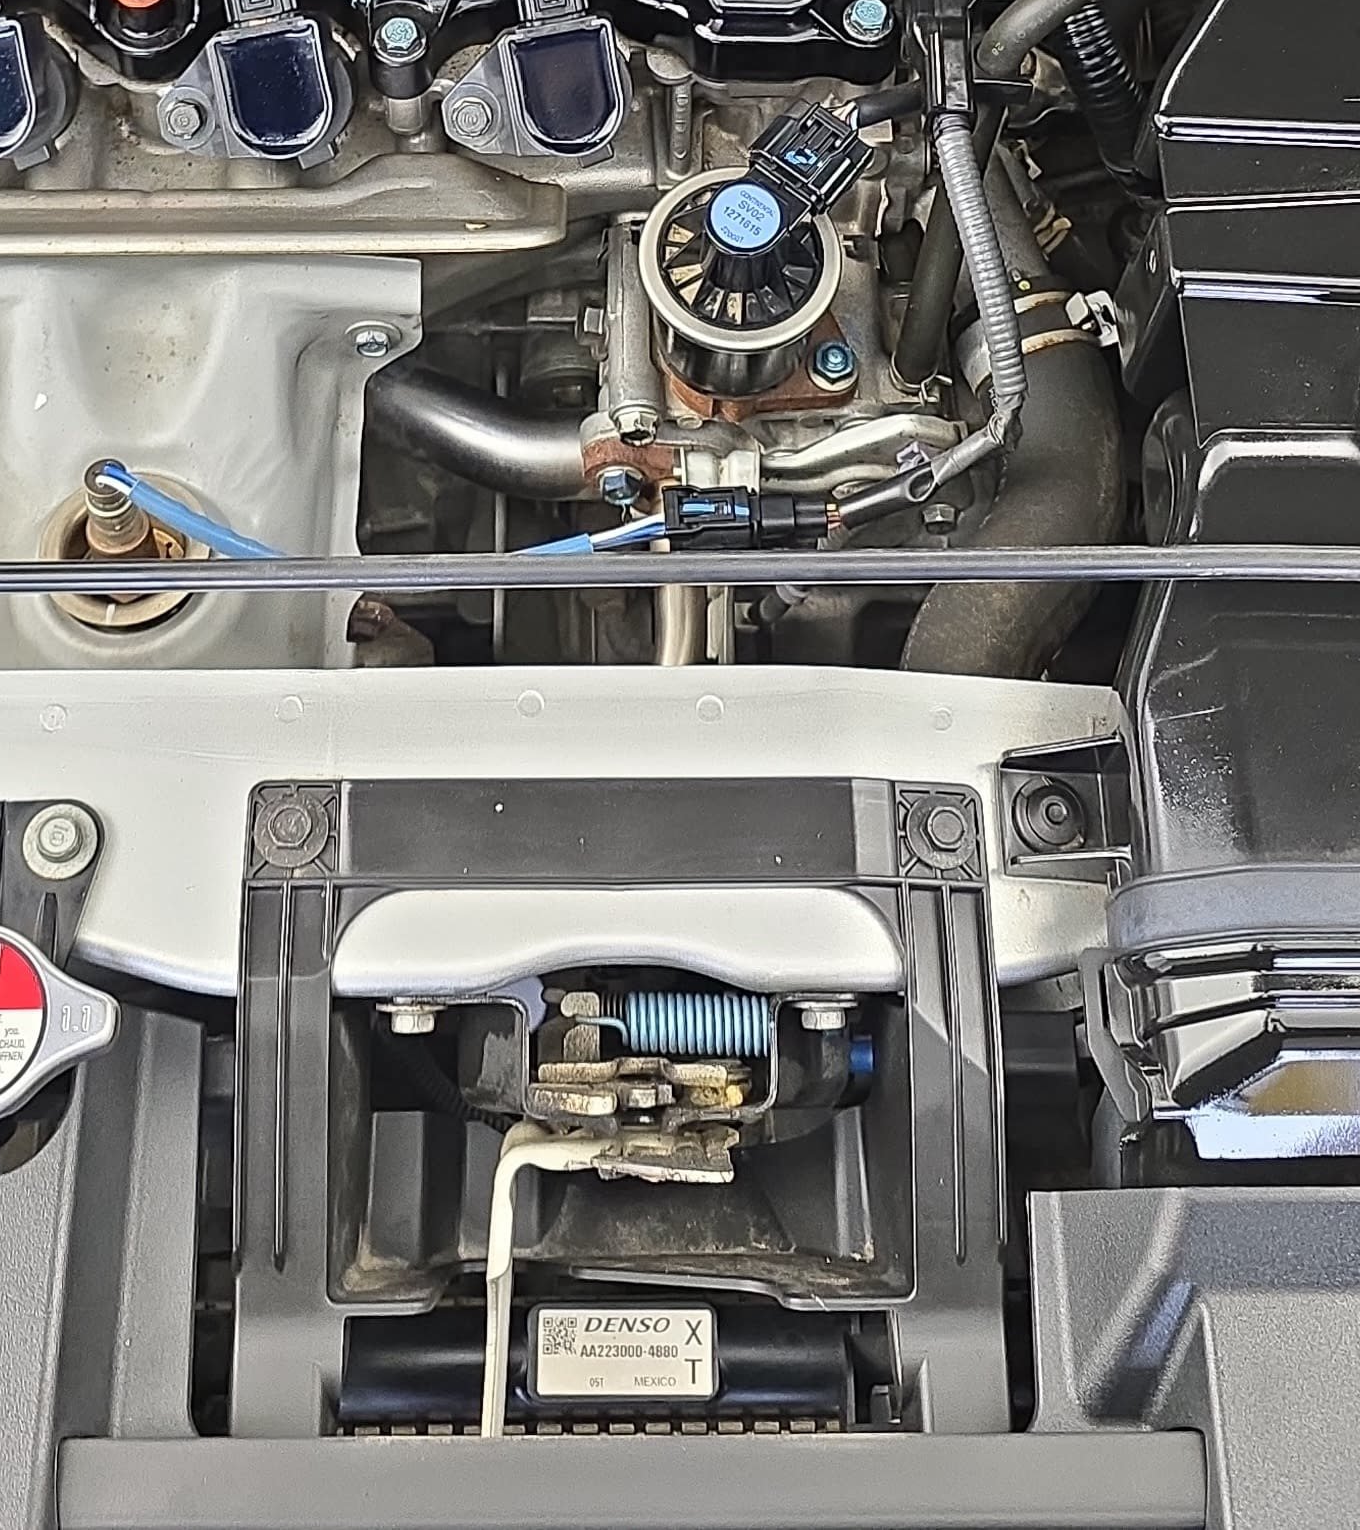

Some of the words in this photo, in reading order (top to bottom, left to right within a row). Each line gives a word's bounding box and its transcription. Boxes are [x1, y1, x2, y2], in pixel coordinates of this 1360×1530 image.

[724, 206, 761, 236] 1271615
[739, 200, 765, 222] SV02
[62, 1005, 91, 1032] 1.1
[584, 1317, 670, 1333] DENSO
[684, 1320, 703, 1346] X
[580, 1345, 678, 1358] AA223000-4880
[589, 1378, 604, 1388] 05T
[634, 1377, 677, 1388] MEXICO
[684, 1358, 703, 1385] T
